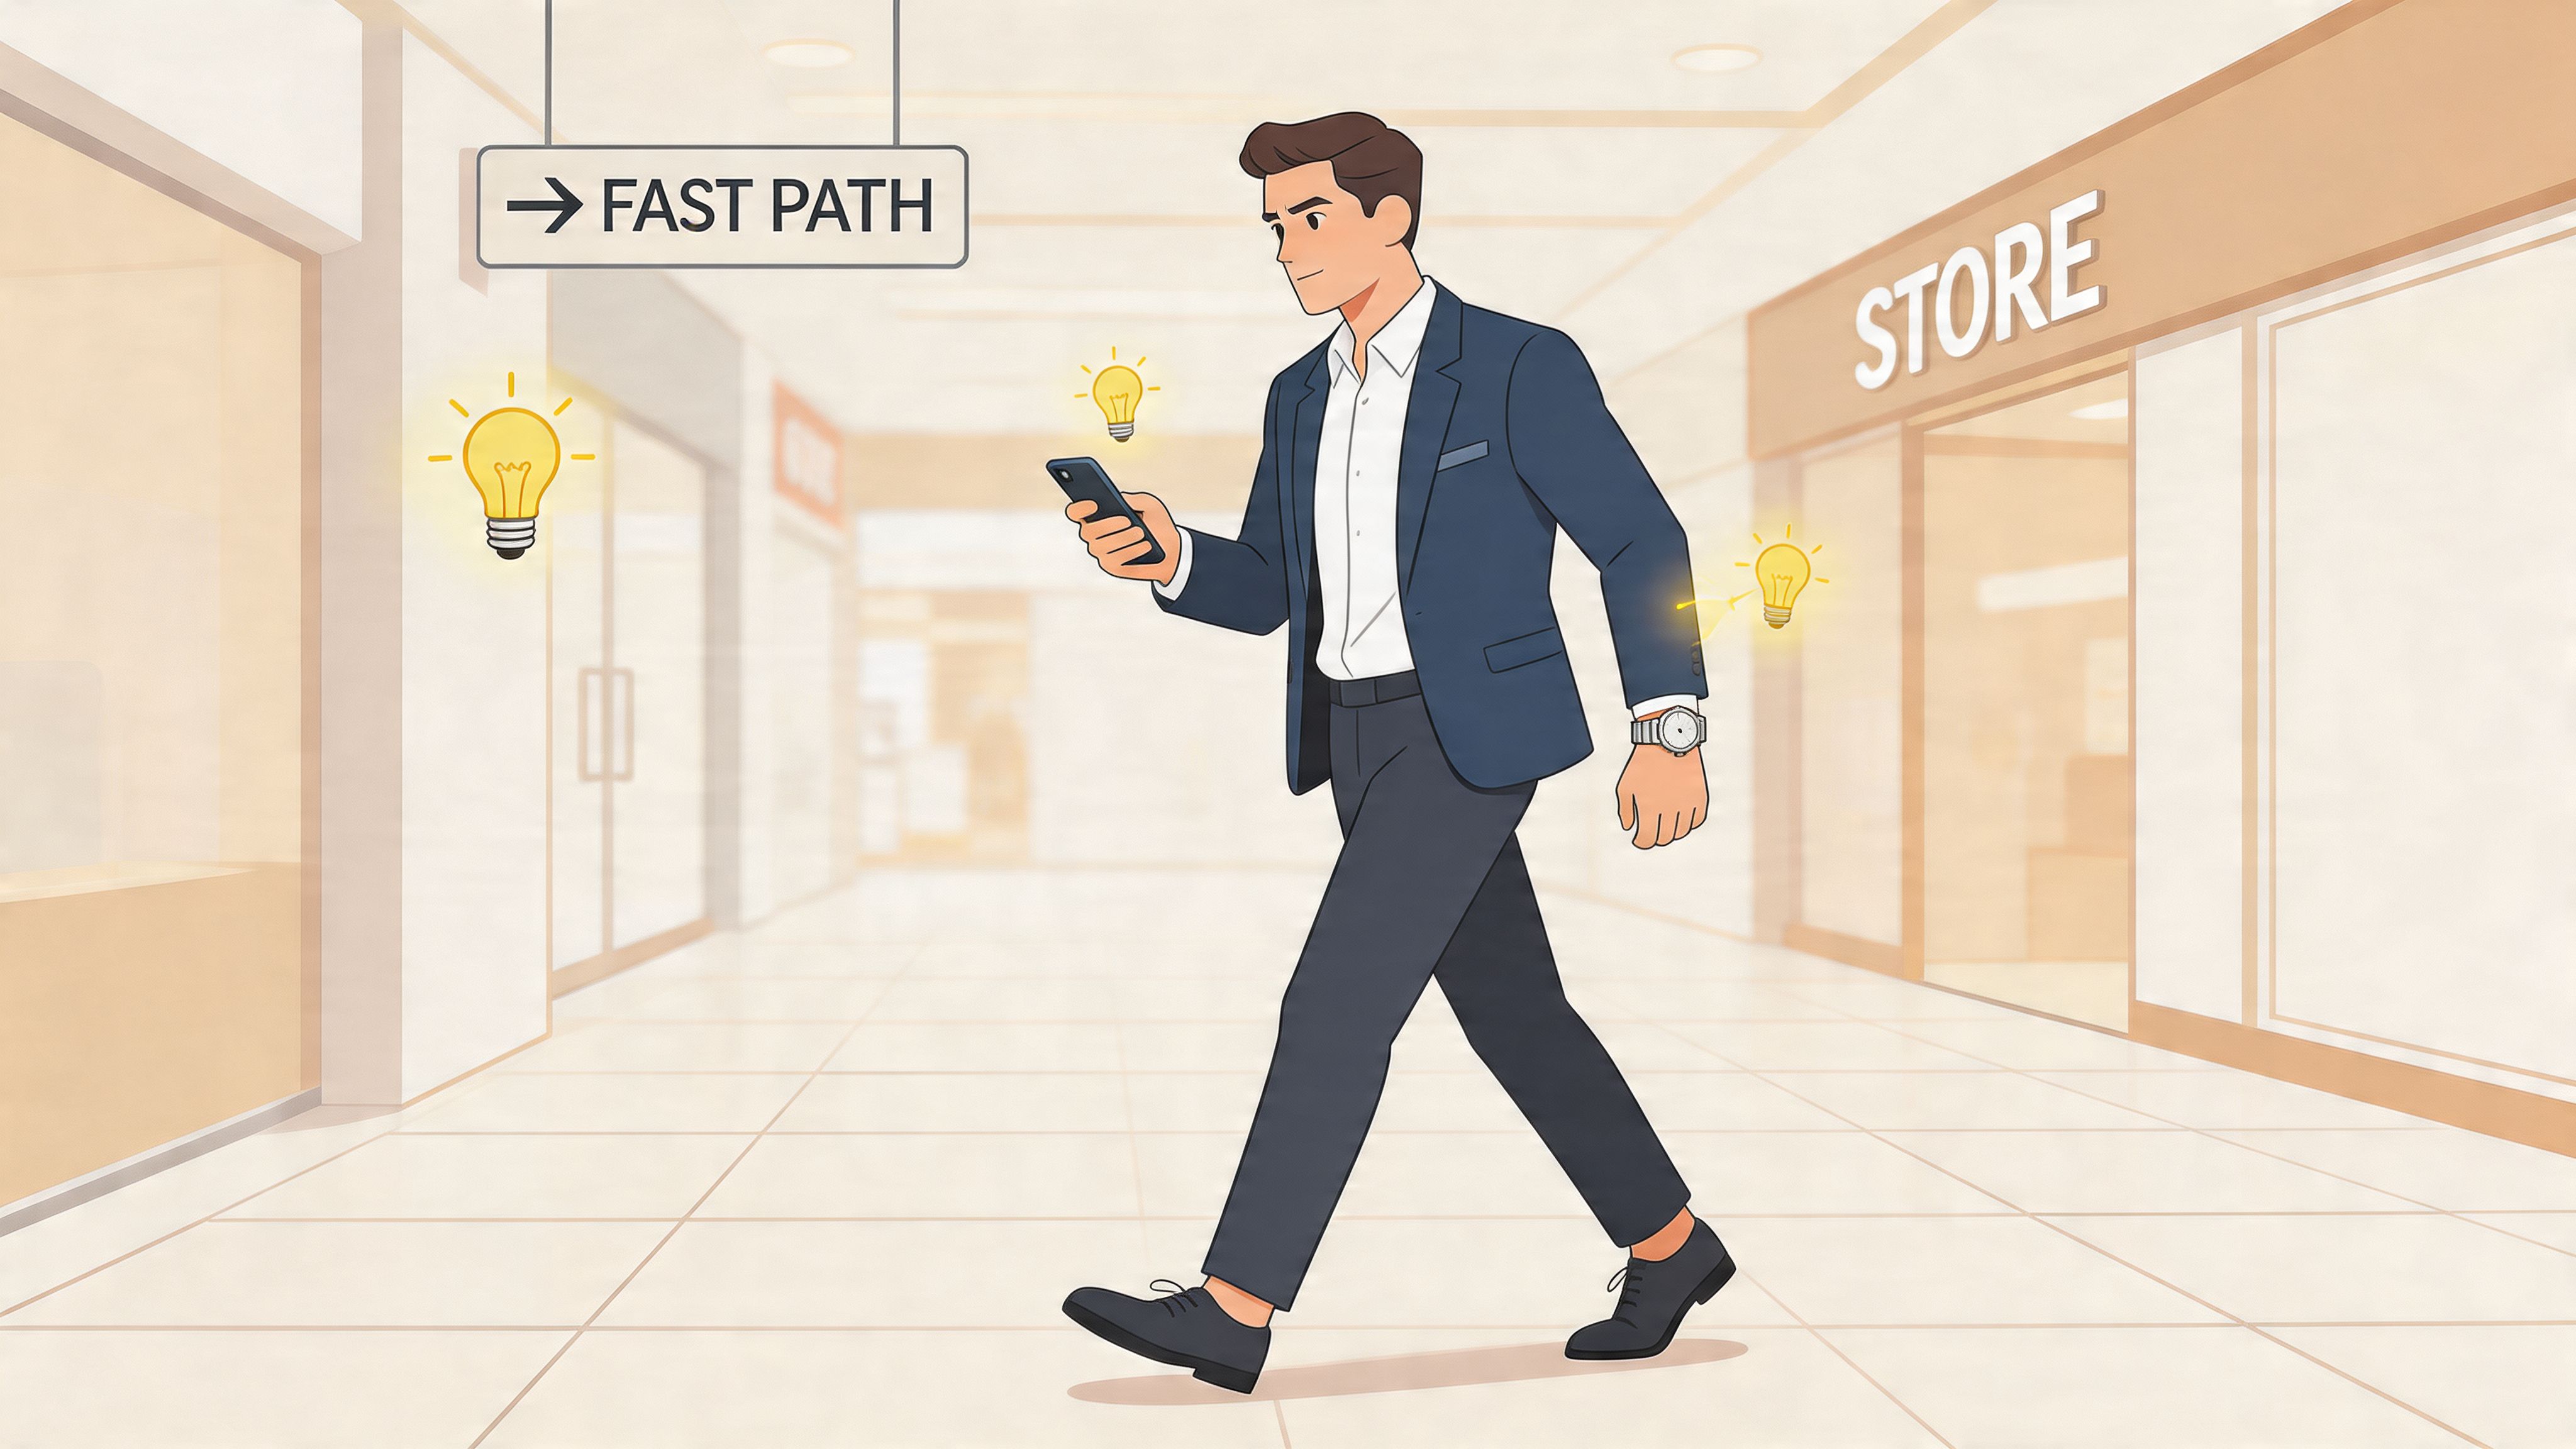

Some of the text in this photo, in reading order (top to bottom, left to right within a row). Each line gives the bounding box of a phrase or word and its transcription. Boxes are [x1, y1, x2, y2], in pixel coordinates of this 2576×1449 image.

[604, 178, 932, 233] FAST PATH
[1855, 189, 2105, 389] STORE
